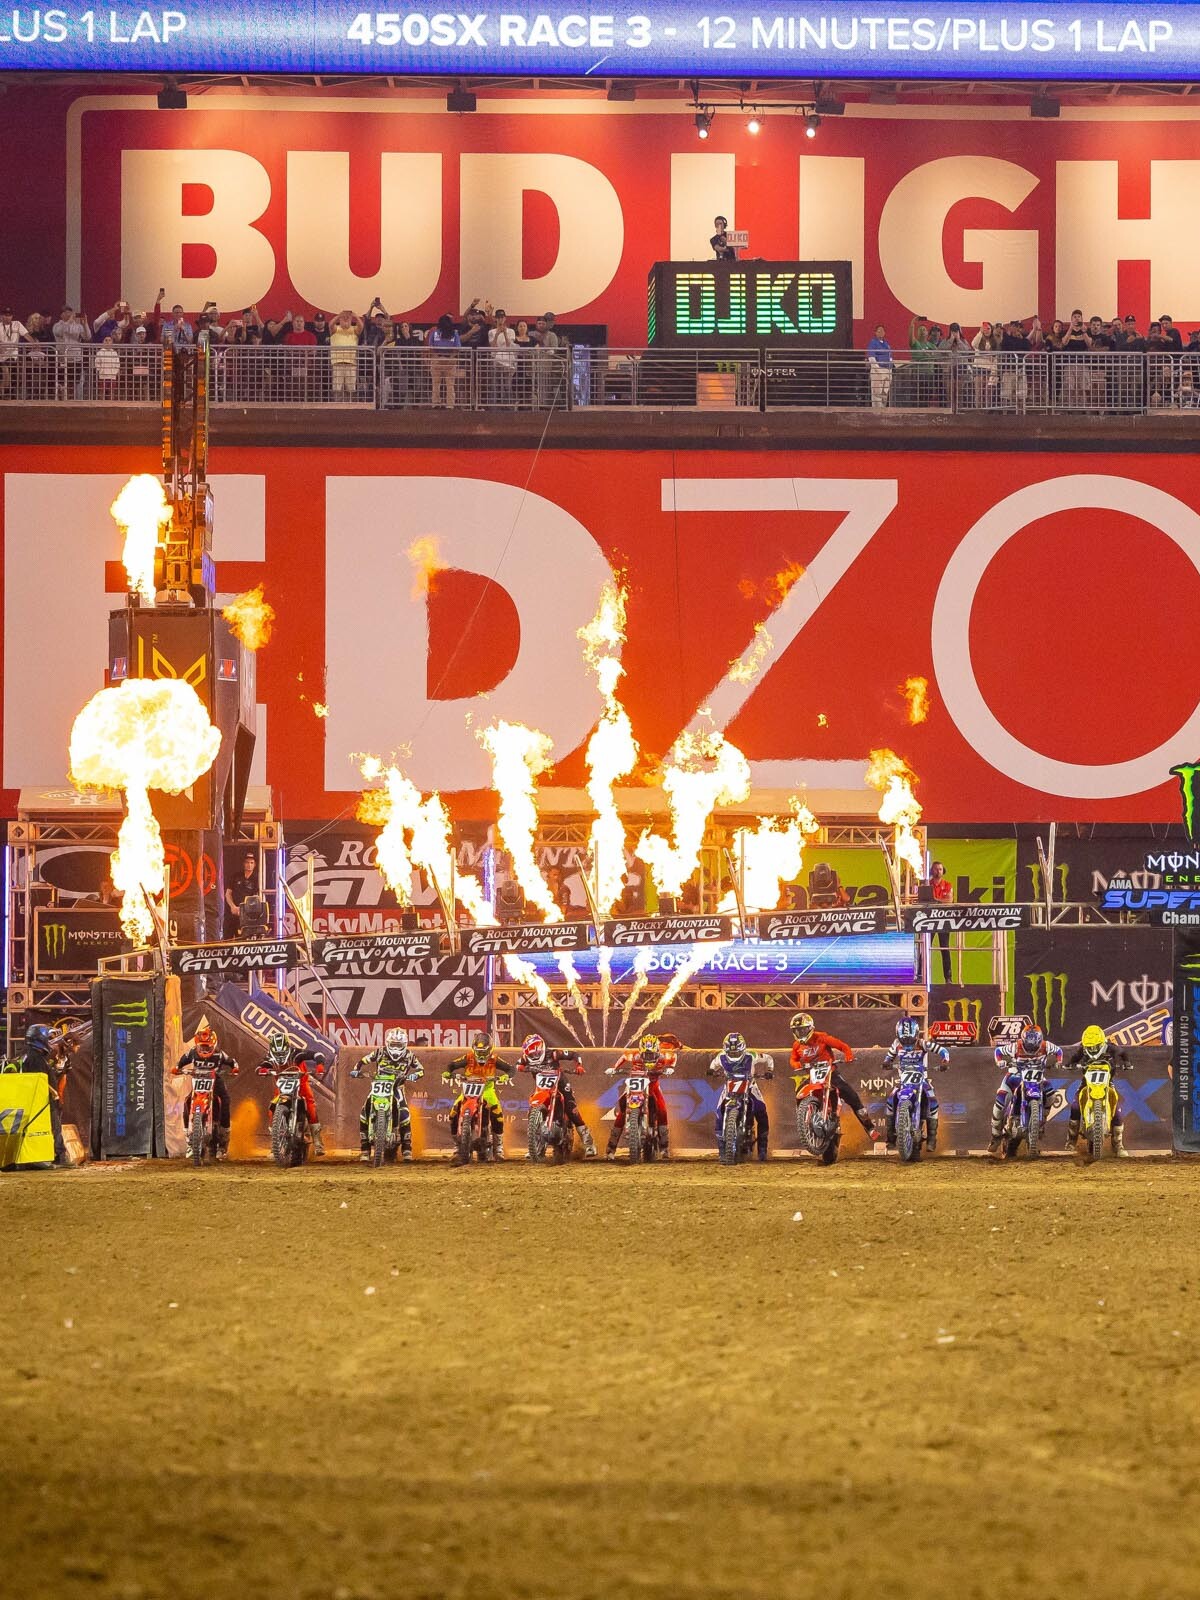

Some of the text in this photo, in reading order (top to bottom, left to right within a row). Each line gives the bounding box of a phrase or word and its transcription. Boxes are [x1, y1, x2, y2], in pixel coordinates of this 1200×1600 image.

[81, 11, 94, 42] 1
[110, 11, 187, 43] LAP
[347, 14, 488, 47] 450SX
[503, 15, 613, 48] RACE
[627, 16, 652, 48] 3
[697, 17, 737, 49] 12
[752, 18, 1054, 53] MINUTES/PLUS
[1071, 20, 1082, 51] 1
[1097, 20, 1173, 52] LAP
[121, 149, 624, 318] BUD
[751, 367, 797, 377] ONSTER
[1109, 879, 1132, 889] AMA
[784, 911, 876, 924] ROCKY MOUNTAIN
[930, 907, 1022, 918] ROCKY MOUNTAIN
[630, 919, 721, 930] ROCKY MOUNTAIN
[68, 931, 123, 941] MONSTER
[486, 927, 577, 939] ROCKY MOUNTAIN
[340, 936, 431, 948] ROCKY MOUNTAIN
[197, 944, 288, 958] ROCKY MOUNTAIN
[709, 953, 769, 971] RACE
[775, 952, 788, 971] 3
[1000, 1022, 1022, 1035] 78
[1180, 1016, 1188, 1100] CHAMPIONSHIP
[107, 1051, 115, 1113] CHAMPIONSHIP
[135, 1053, 147, 1112] MONSTER
[901, 1072, 922, 1083] 78
[1024, 1071, 1043, 1082] 44
[1091, 1073, 1106, 1082] 11
[194, 1080, 212, 1090] 160
[373, 1083, 392, 1094] 519
[538, 1078, 555, 1088] 45
[629, 1078, 645, 1090] 51
[465, 1085, 483, 1095] 111
